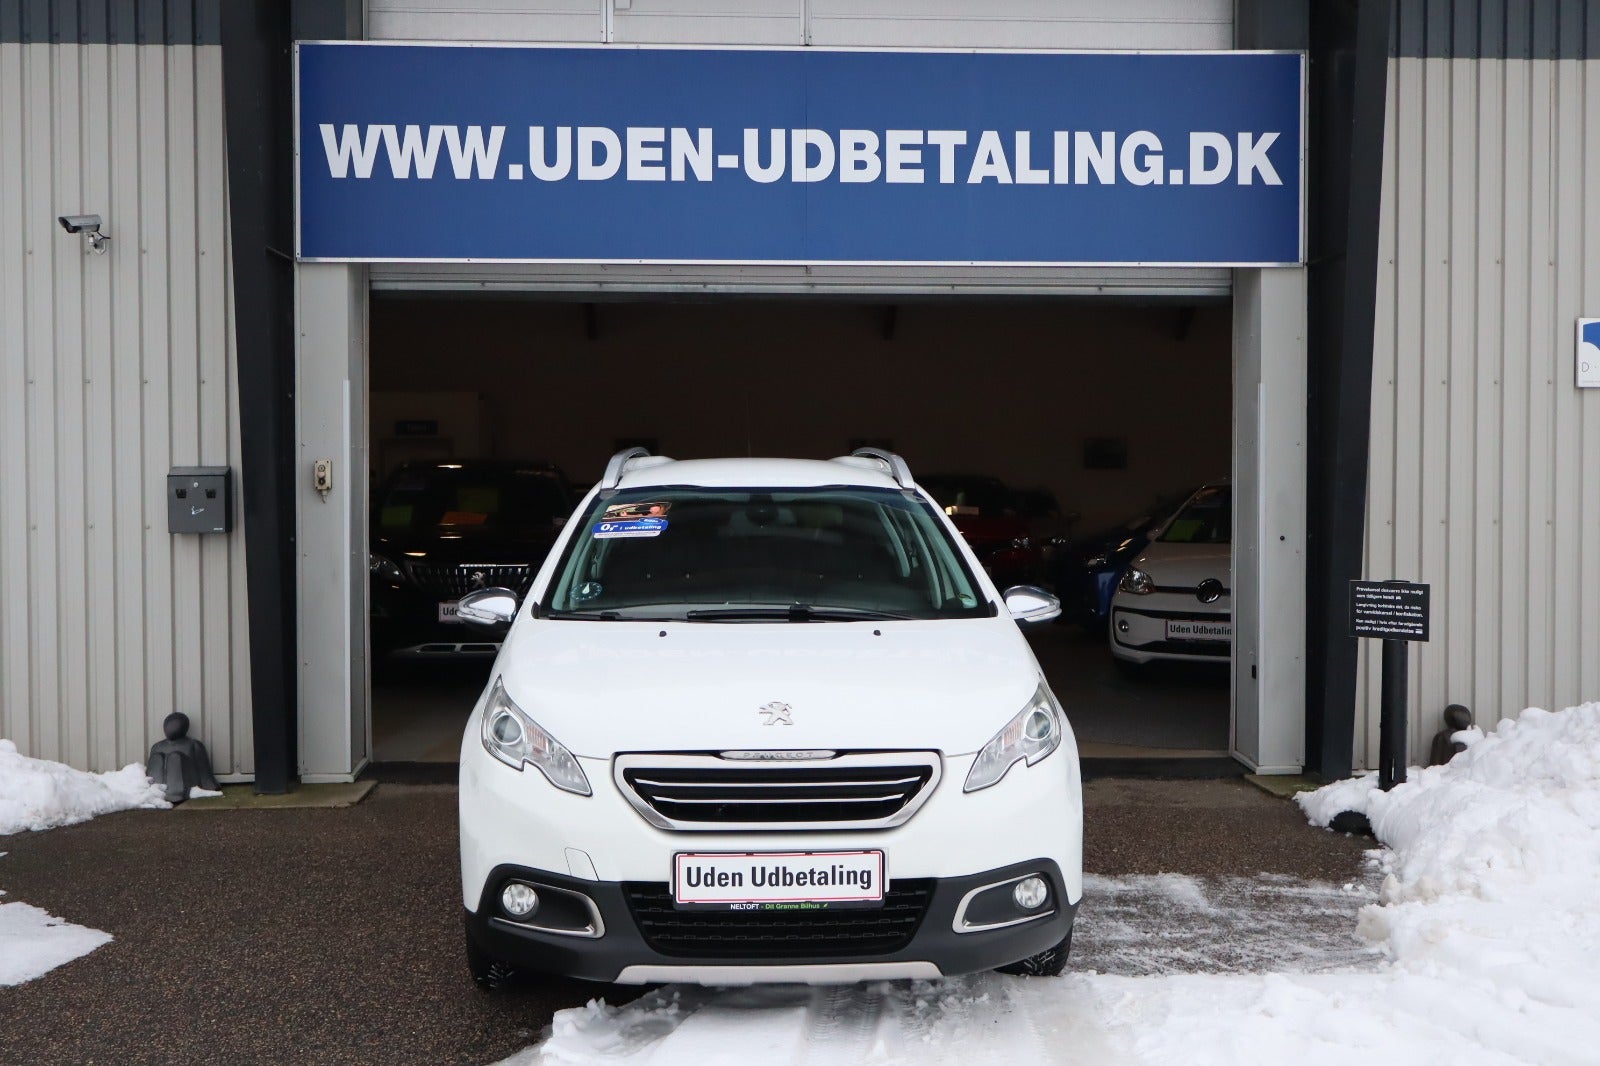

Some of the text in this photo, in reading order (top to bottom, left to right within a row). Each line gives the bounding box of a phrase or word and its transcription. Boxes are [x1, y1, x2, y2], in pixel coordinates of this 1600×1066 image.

[318, 123, 1284, 187] WWW.UDEN-UDBETALING.DK
[1170, 624, 1231, 636] Uden Udbetalin
[743, 752, 814, 760] PEUGEOT
[686, 865, 872, 890] Uden Udbetaling
